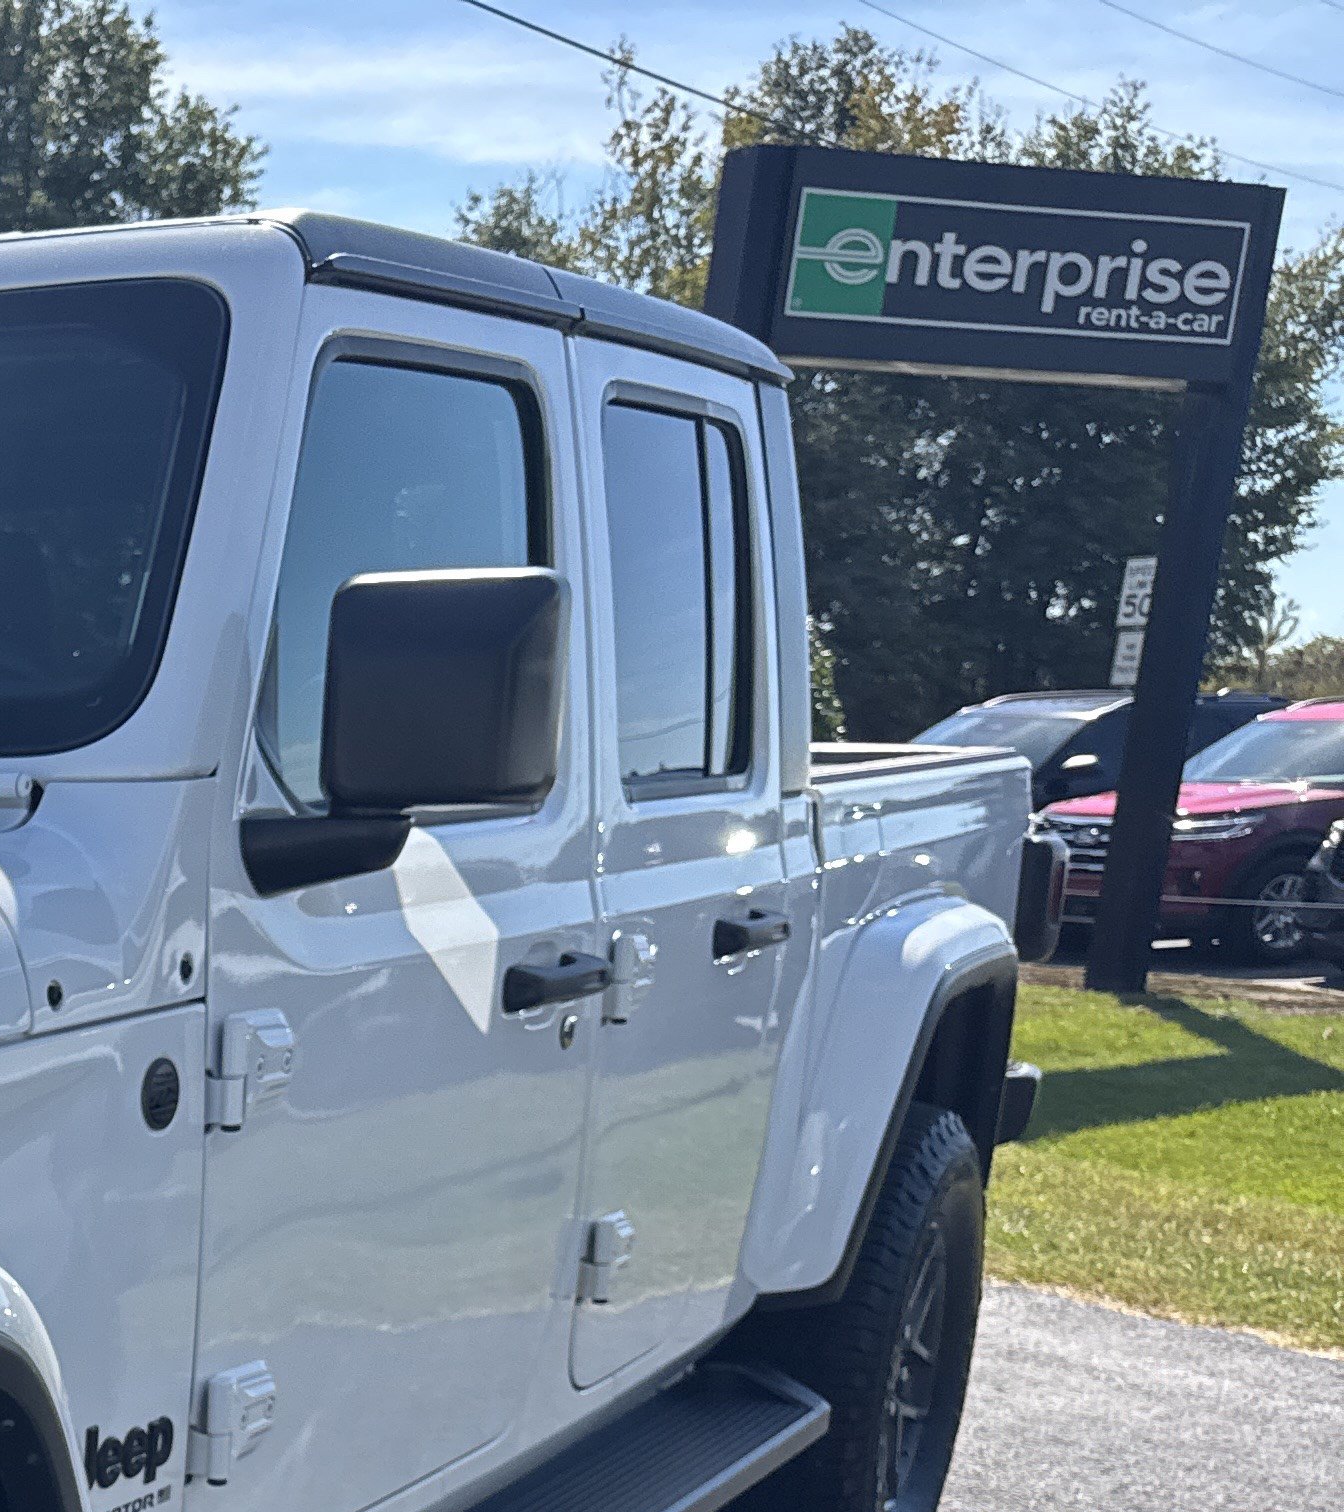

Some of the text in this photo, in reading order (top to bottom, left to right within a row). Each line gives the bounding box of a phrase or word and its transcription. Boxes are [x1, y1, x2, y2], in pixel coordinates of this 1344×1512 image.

[823, 228, 1232, 315] enterprise
[1077, 304, 1225, 334] rent-a-car
[1122, 592, 1152, 618] 50
